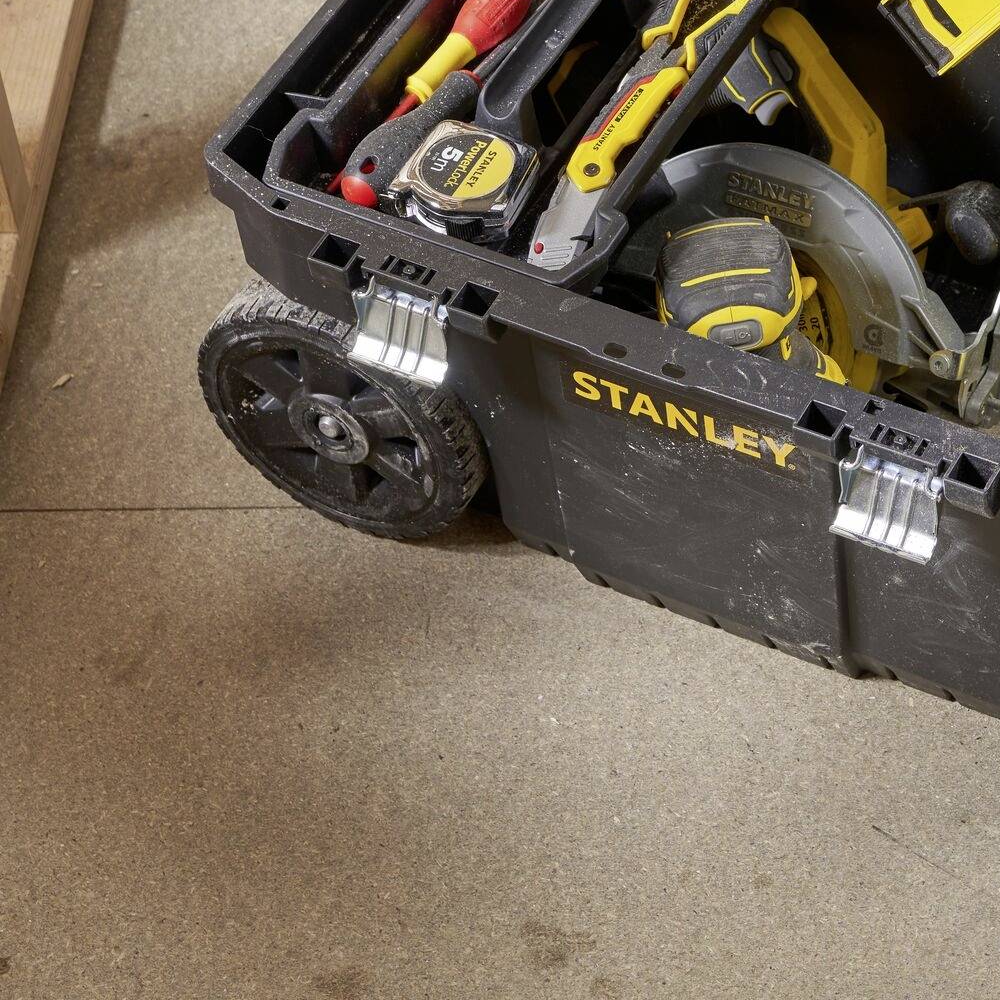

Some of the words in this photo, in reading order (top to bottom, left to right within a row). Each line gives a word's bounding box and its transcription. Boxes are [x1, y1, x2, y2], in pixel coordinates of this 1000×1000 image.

[593, 123, 617, 152] STANLEY
[466, 150, 497, 188] STANLEY
[727, 172, 814, 210] STANLEY
[572, 371, 798, 468] STANLEY
